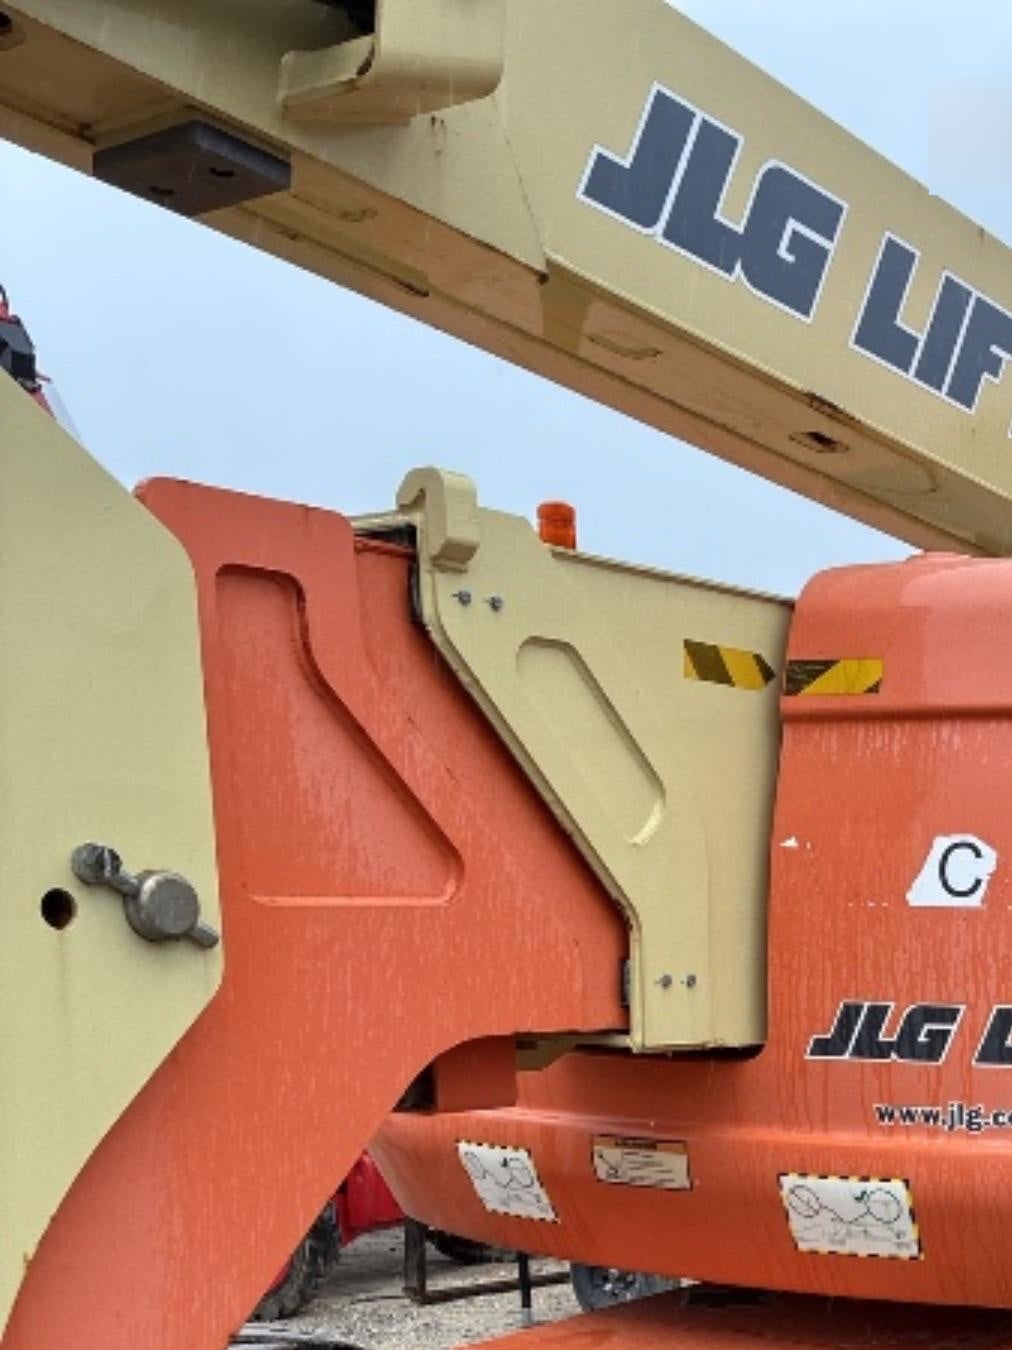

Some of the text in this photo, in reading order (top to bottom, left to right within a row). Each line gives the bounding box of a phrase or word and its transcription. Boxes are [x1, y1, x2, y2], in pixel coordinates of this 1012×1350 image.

[576, 80, 849, 324] JLG
[938, 841, 983, 898] C
[804, 1000, 966, 1065] JLG
